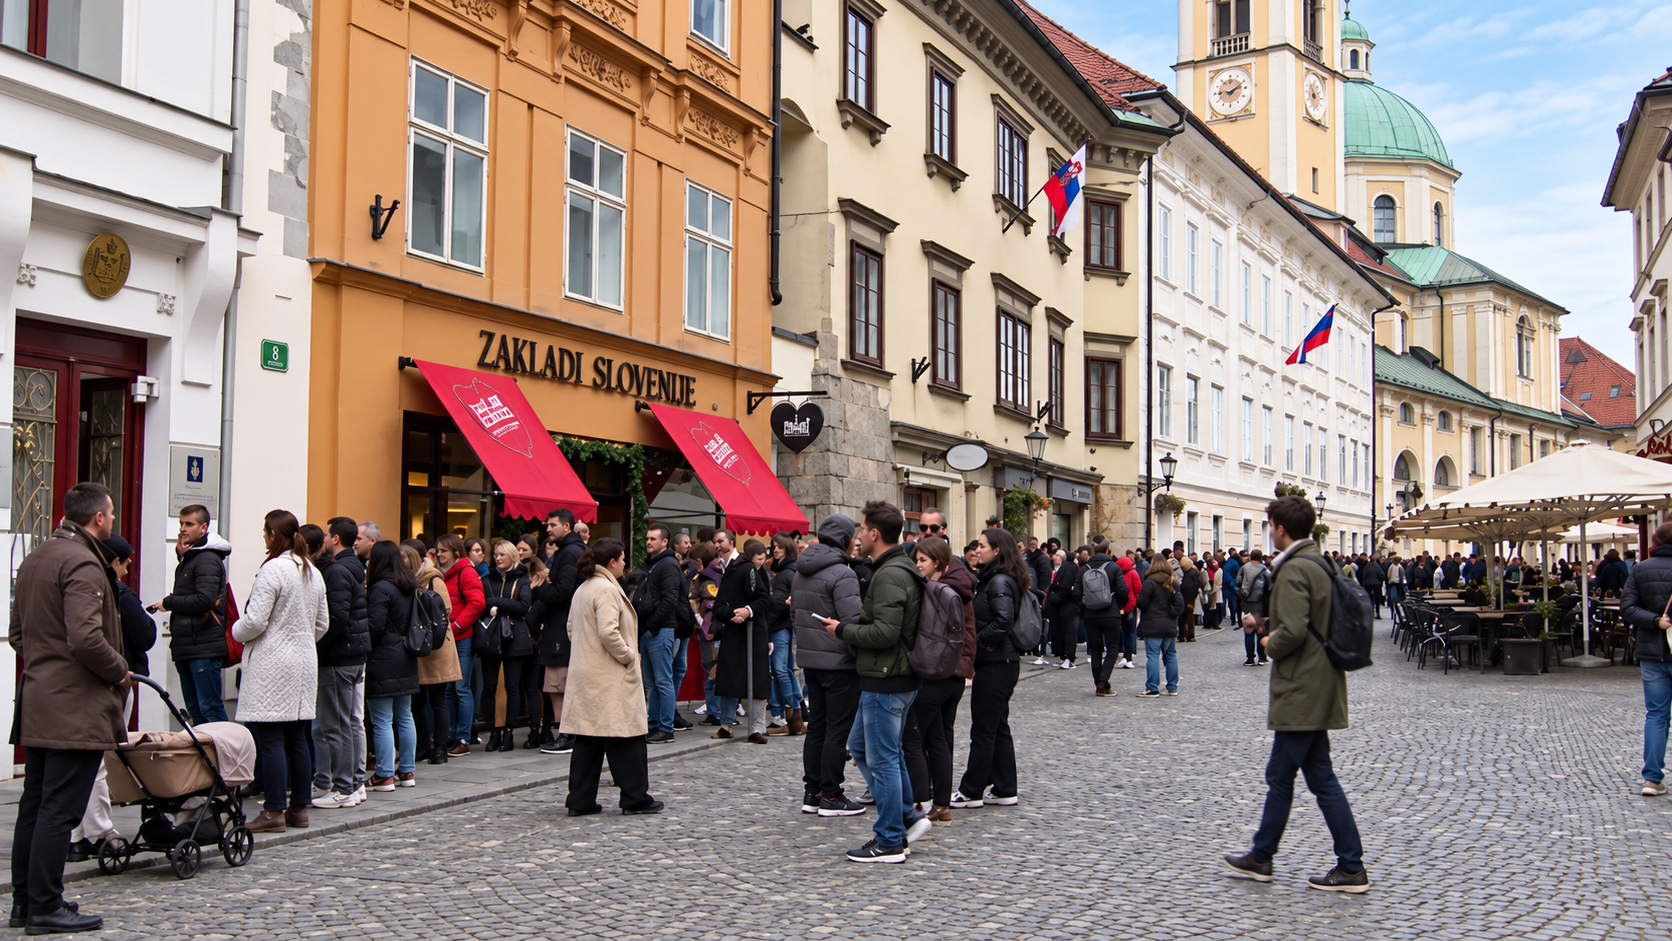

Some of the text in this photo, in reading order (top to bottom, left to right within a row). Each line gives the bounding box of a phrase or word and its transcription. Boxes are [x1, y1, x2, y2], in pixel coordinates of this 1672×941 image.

[272, 345, 279, 361] 8
[477, 330, 696, 406] ZAKLADI SLOVENIJE
